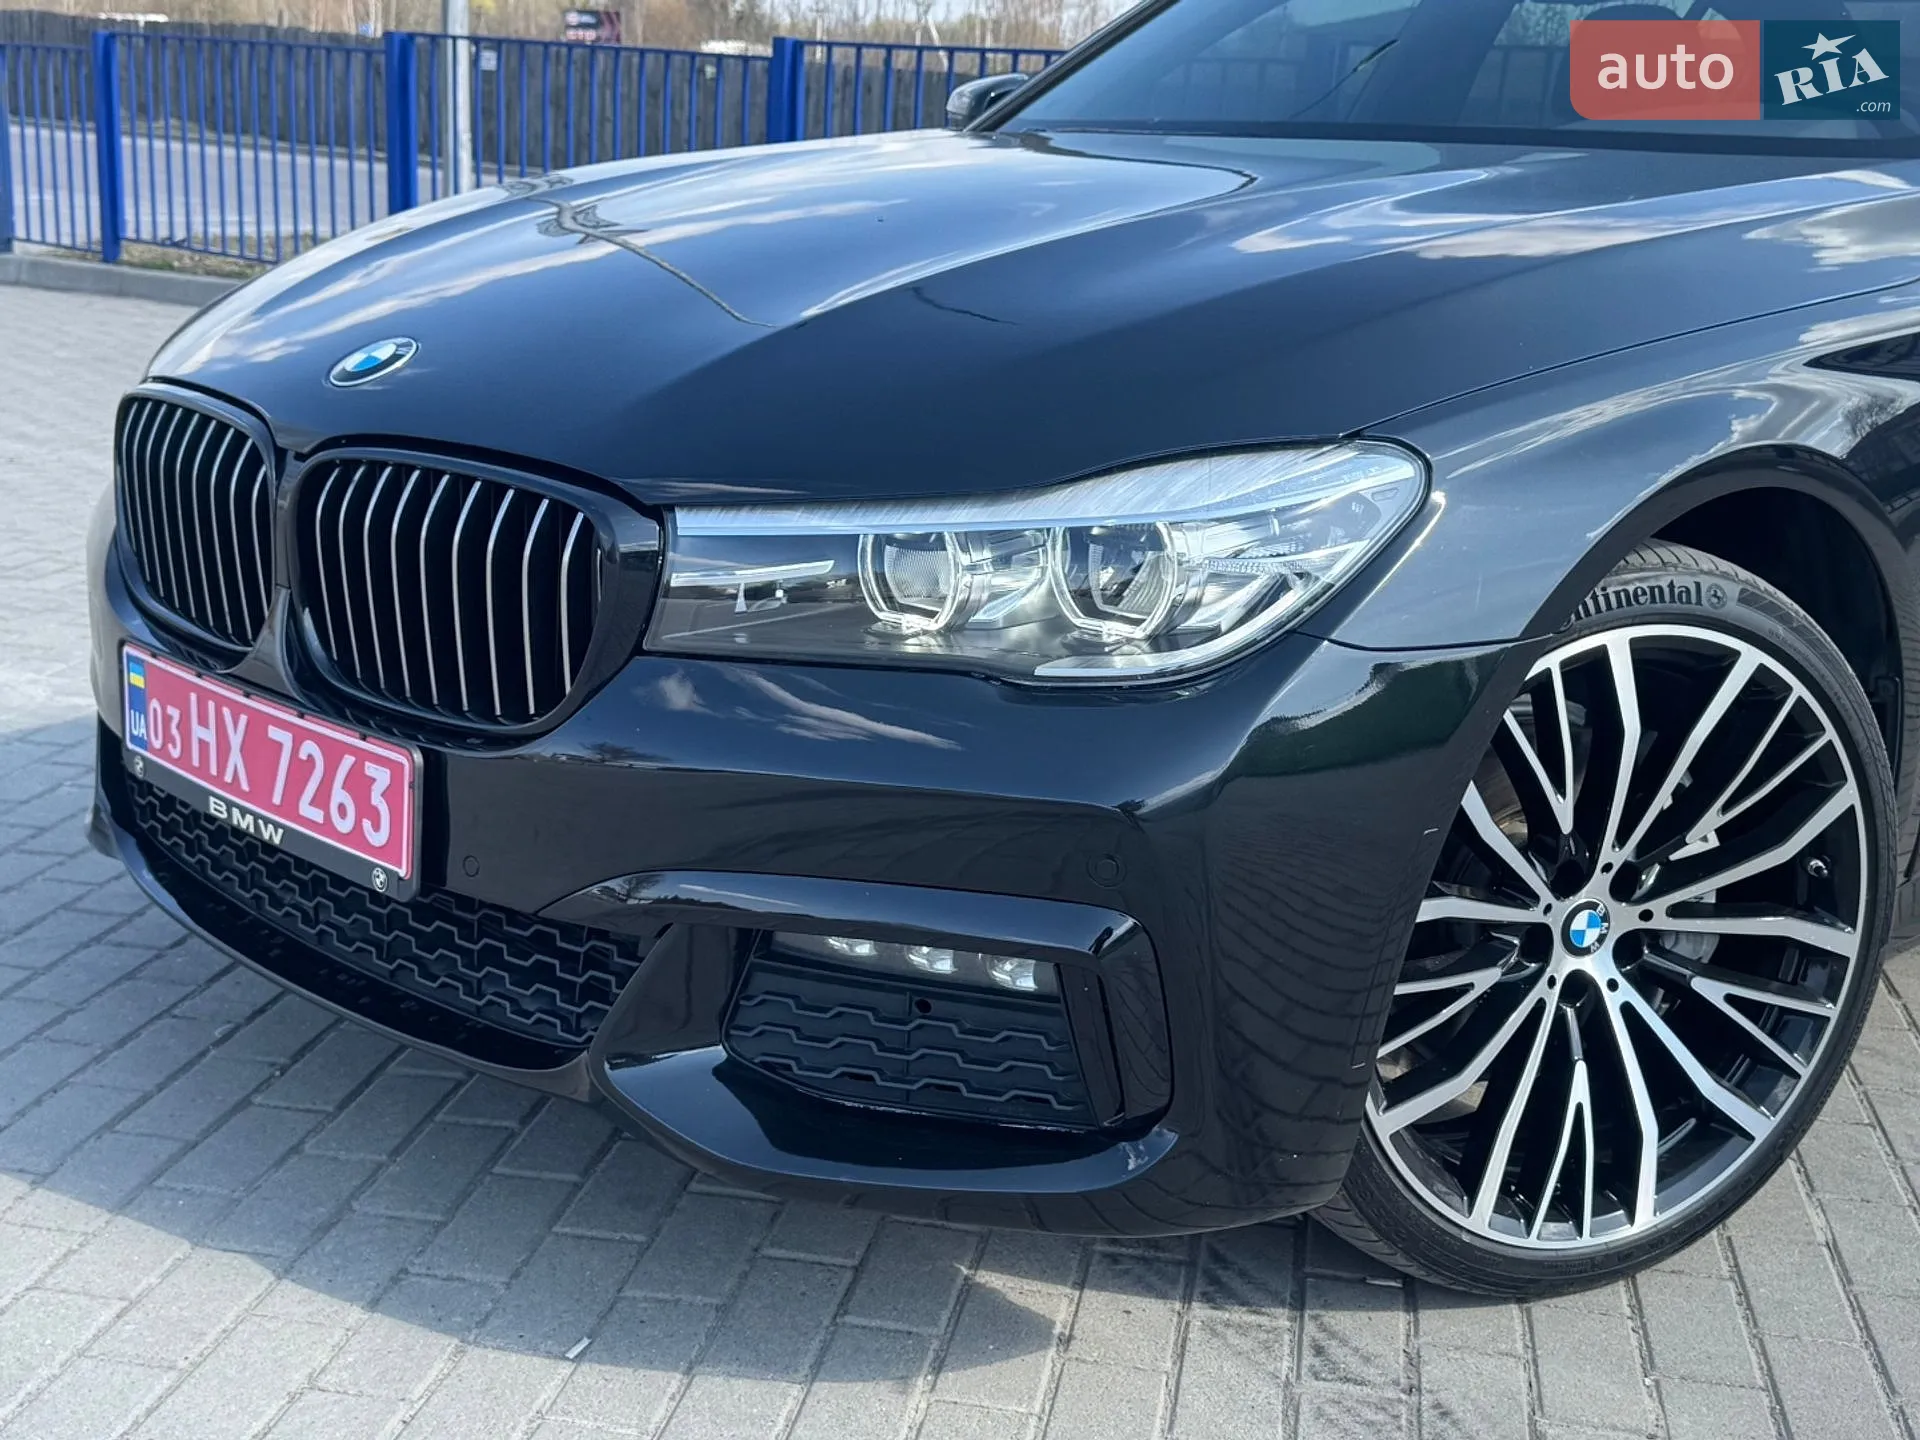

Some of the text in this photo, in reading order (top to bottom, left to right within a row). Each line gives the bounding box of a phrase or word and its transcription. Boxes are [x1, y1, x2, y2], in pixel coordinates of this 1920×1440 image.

[1573, 579, 1704, 621] ntinental
[130, 709, 147, 741] UA
[267, 725, 391, 847] 7263
[208, 795, 284, 845] BMW
